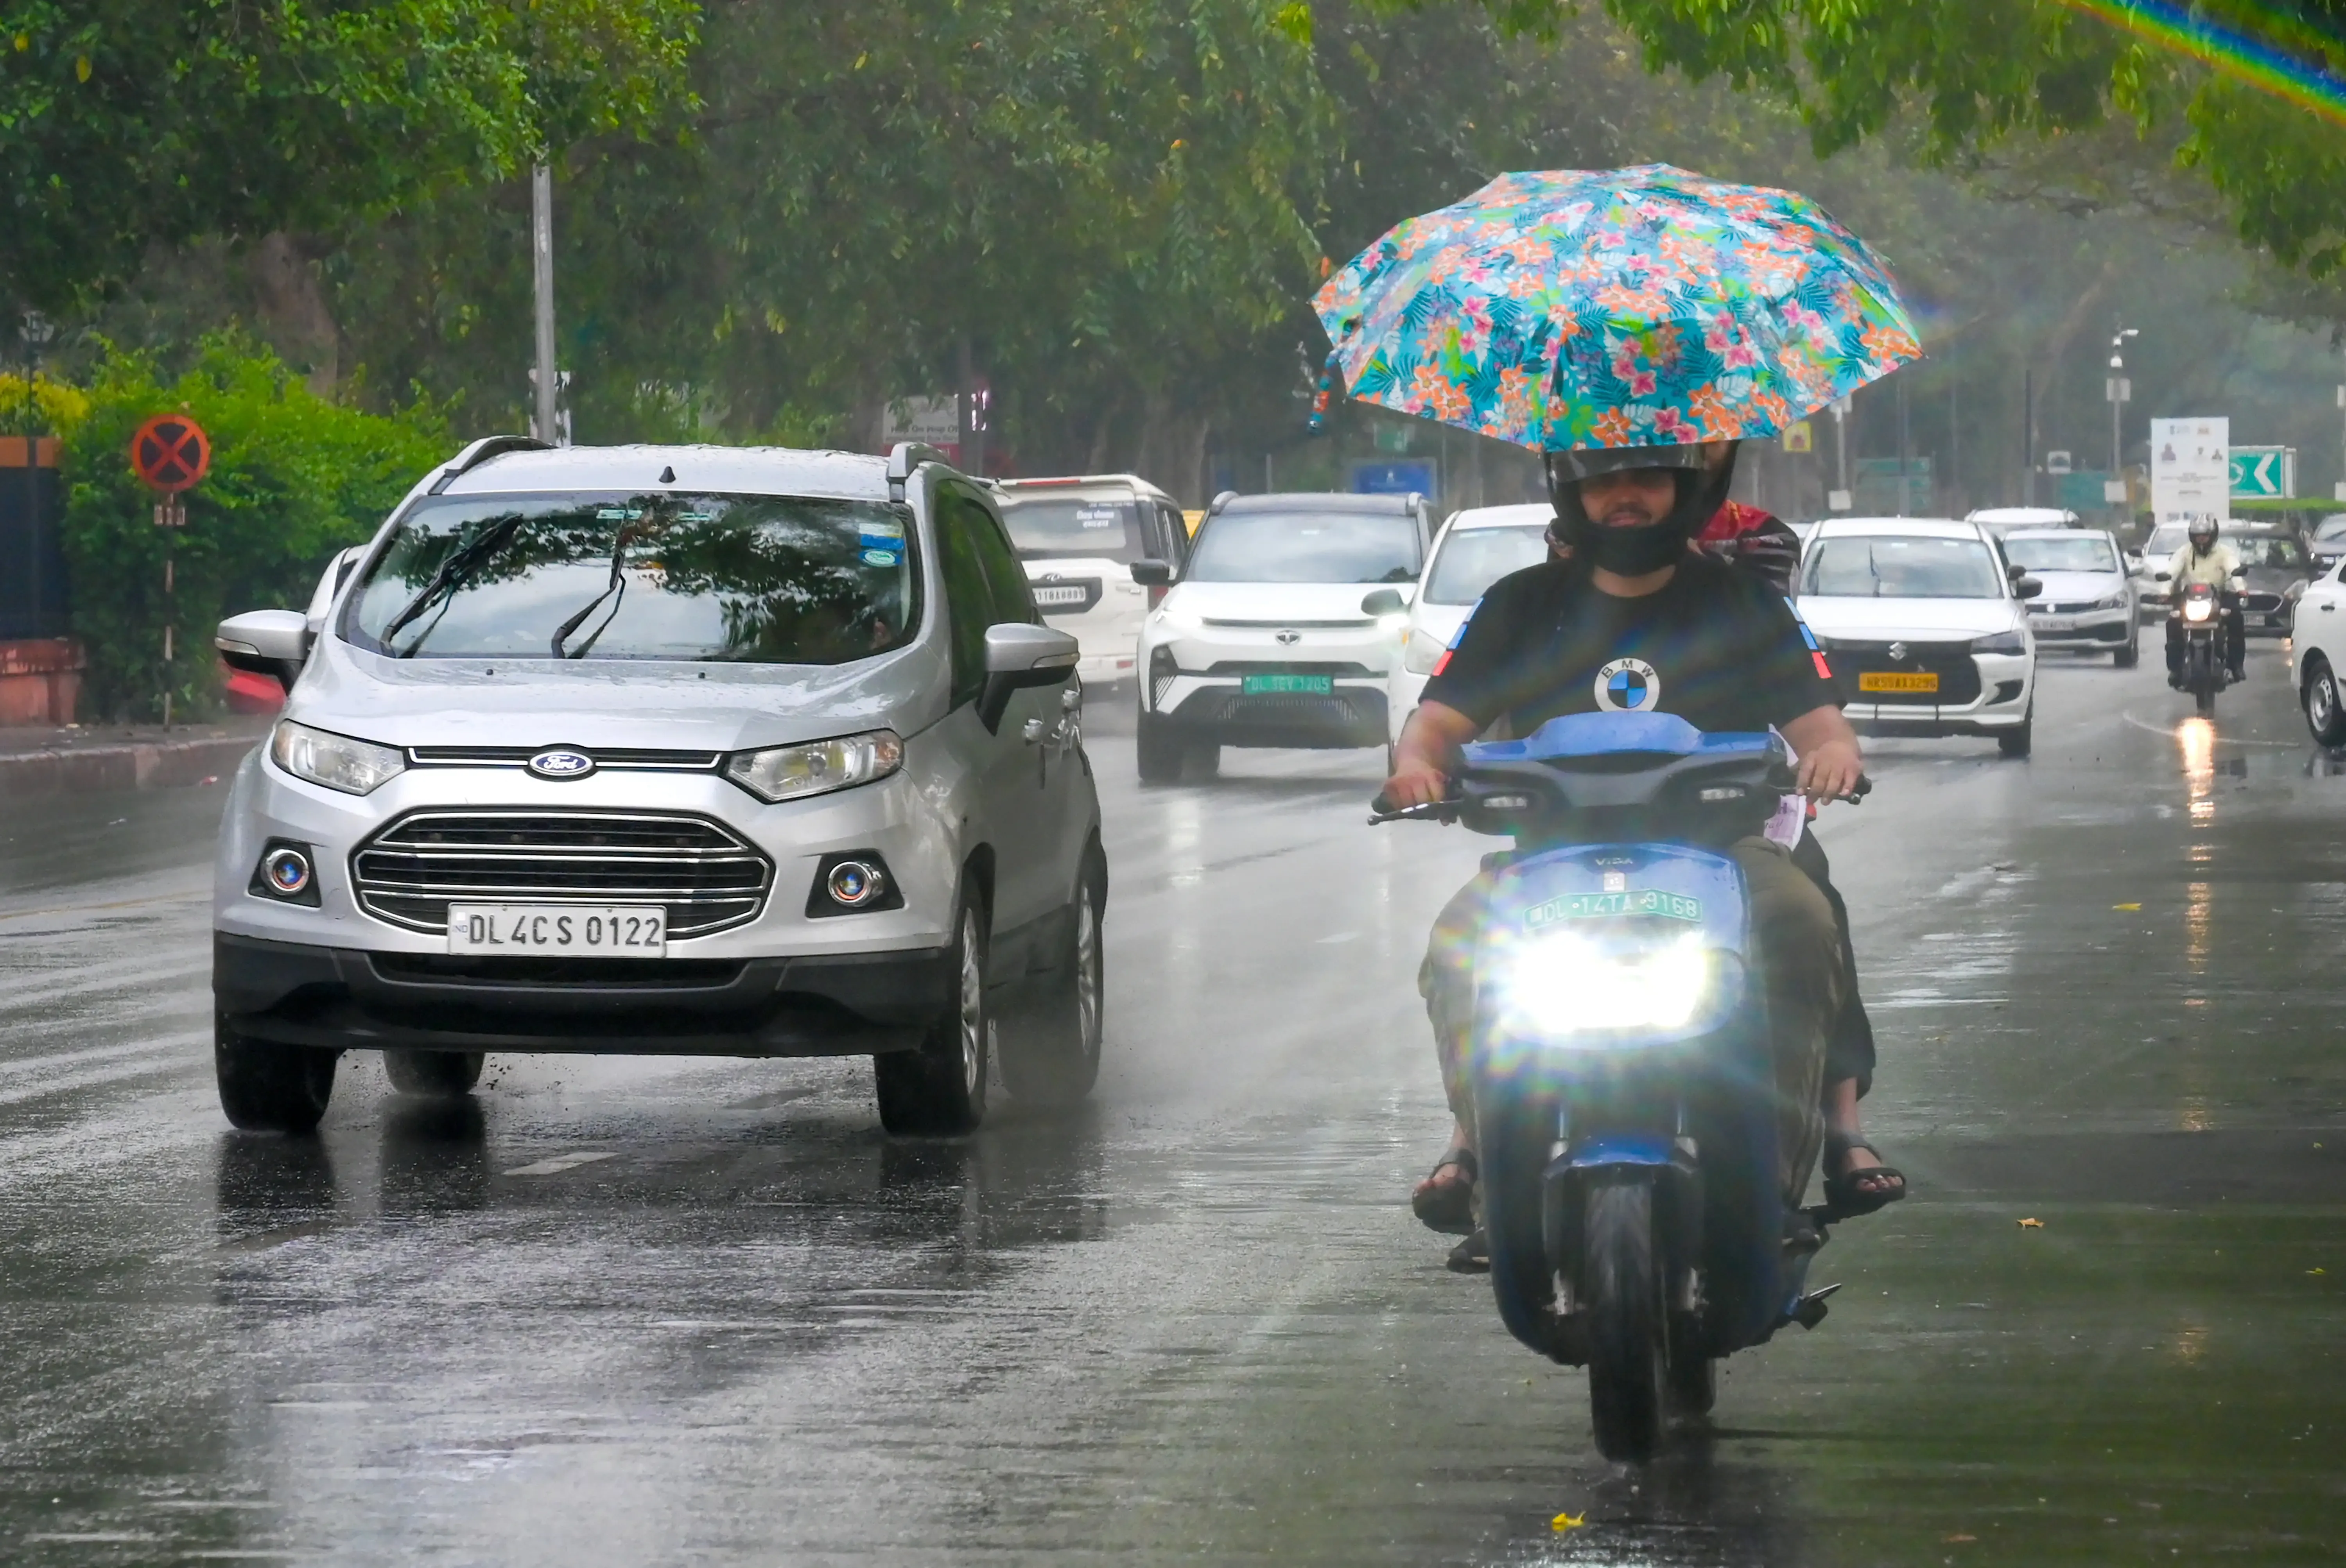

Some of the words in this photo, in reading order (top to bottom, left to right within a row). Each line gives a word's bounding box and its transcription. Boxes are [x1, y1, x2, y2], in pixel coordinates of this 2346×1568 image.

[1602, 659, 1654, 679] BMW
[543, 755, 579, 770] Ford
[1543, 902, 1566, 923] DL
[586, 916, 660, 947] 0122
